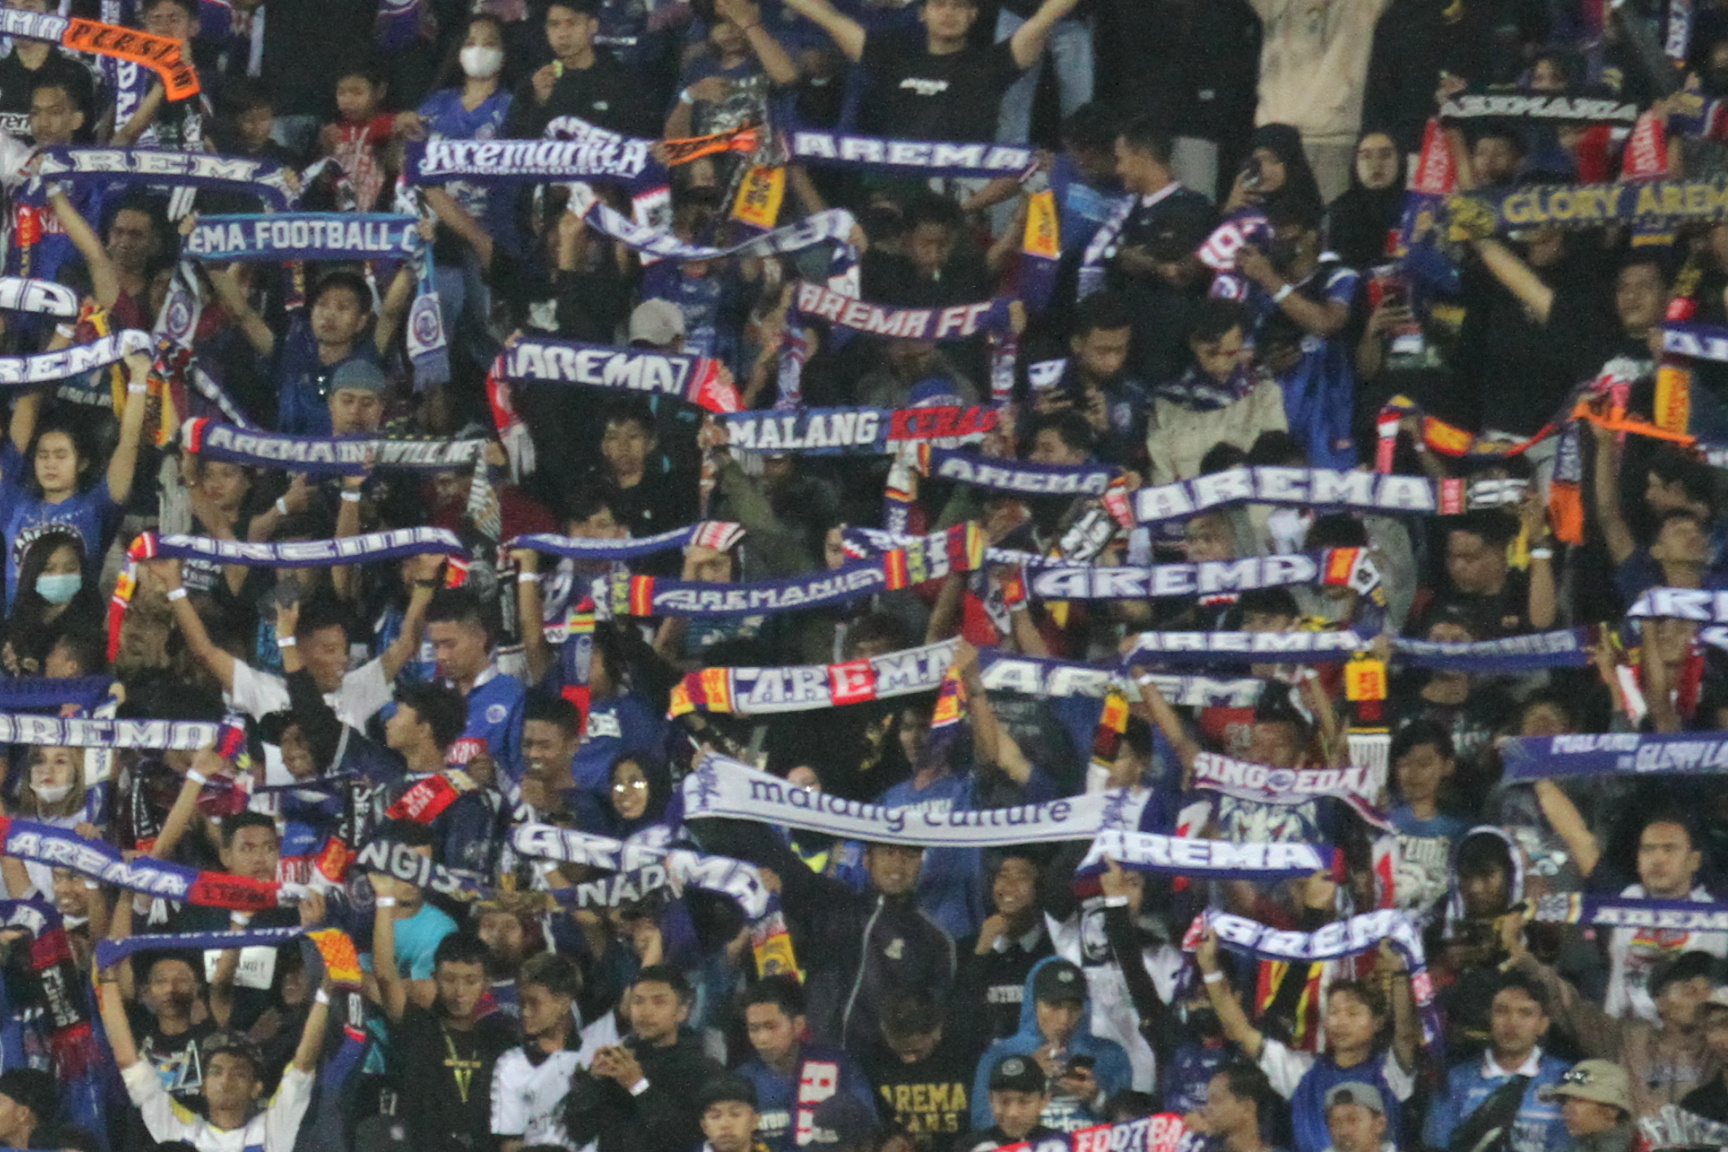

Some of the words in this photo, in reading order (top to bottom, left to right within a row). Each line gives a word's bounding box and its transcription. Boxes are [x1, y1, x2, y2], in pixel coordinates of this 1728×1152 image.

[793, 133, 1030, 170] AREMA
[1502, 188, 1621, 224] GLORY
[188, 223, 246, 253] EMA
[254, 221, 391, 252] FOOTBALL
[799, 280, 932, 338] AREMA
[209, 428, 334, 463] AREMA
[727, 412, 880, 451] MALANG
[939, 457, 1109, 494] AREMA
[1139, 465, 1438, 519] AREMA
[1034, 553, 1318, 598] AREMA
[1135, 630, 1361, 652] AREMA
[980, 657, 1267, 707] AREM
[8, 828, 189, 896] AREMA
